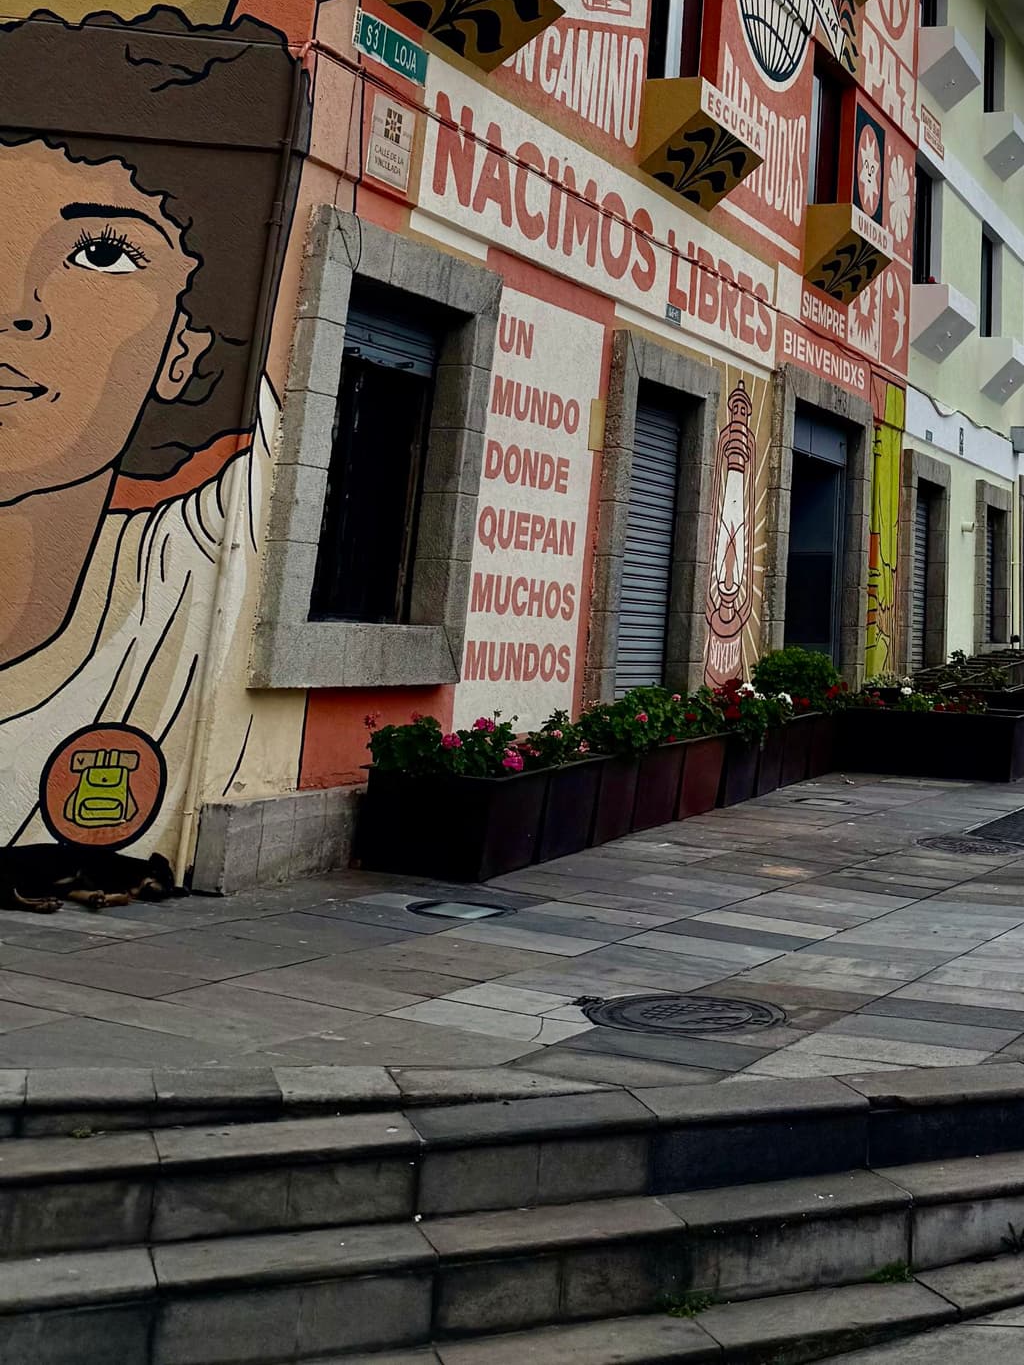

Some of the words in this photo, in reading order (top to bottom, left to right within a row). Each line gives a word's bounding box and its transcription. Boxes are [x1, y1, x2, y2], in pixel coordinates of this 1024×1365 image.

[394, 41, 418, 74] LOJA
[539, 24, 645, 148] CAMINO
[862, 19, 918, 147] PAZ
[707, 91, 761, 151] ESCUCHA
[375, 144, 390, 158] CALLE
[390, 152, 397, 162] DE
[432, 91, 657, 292] NACIMOS
[668, 229, 773, 352] LIBRES
[858, 215, 888, 250] UNIDAD
[499, 313, 534, 359] UN
[802, 291, 846, 338] SIEMPRE
[783, 330, 865, 390] BIENVENIDXS
[491, 375, 580, 434] MUNDO
[484, 439, 570, 494] DONDE
[478, 506, 576, 556] QUEPAN
[470, 572, 576, 621] MUCHOS
[463, 640, 571, 682] MUNDOS
